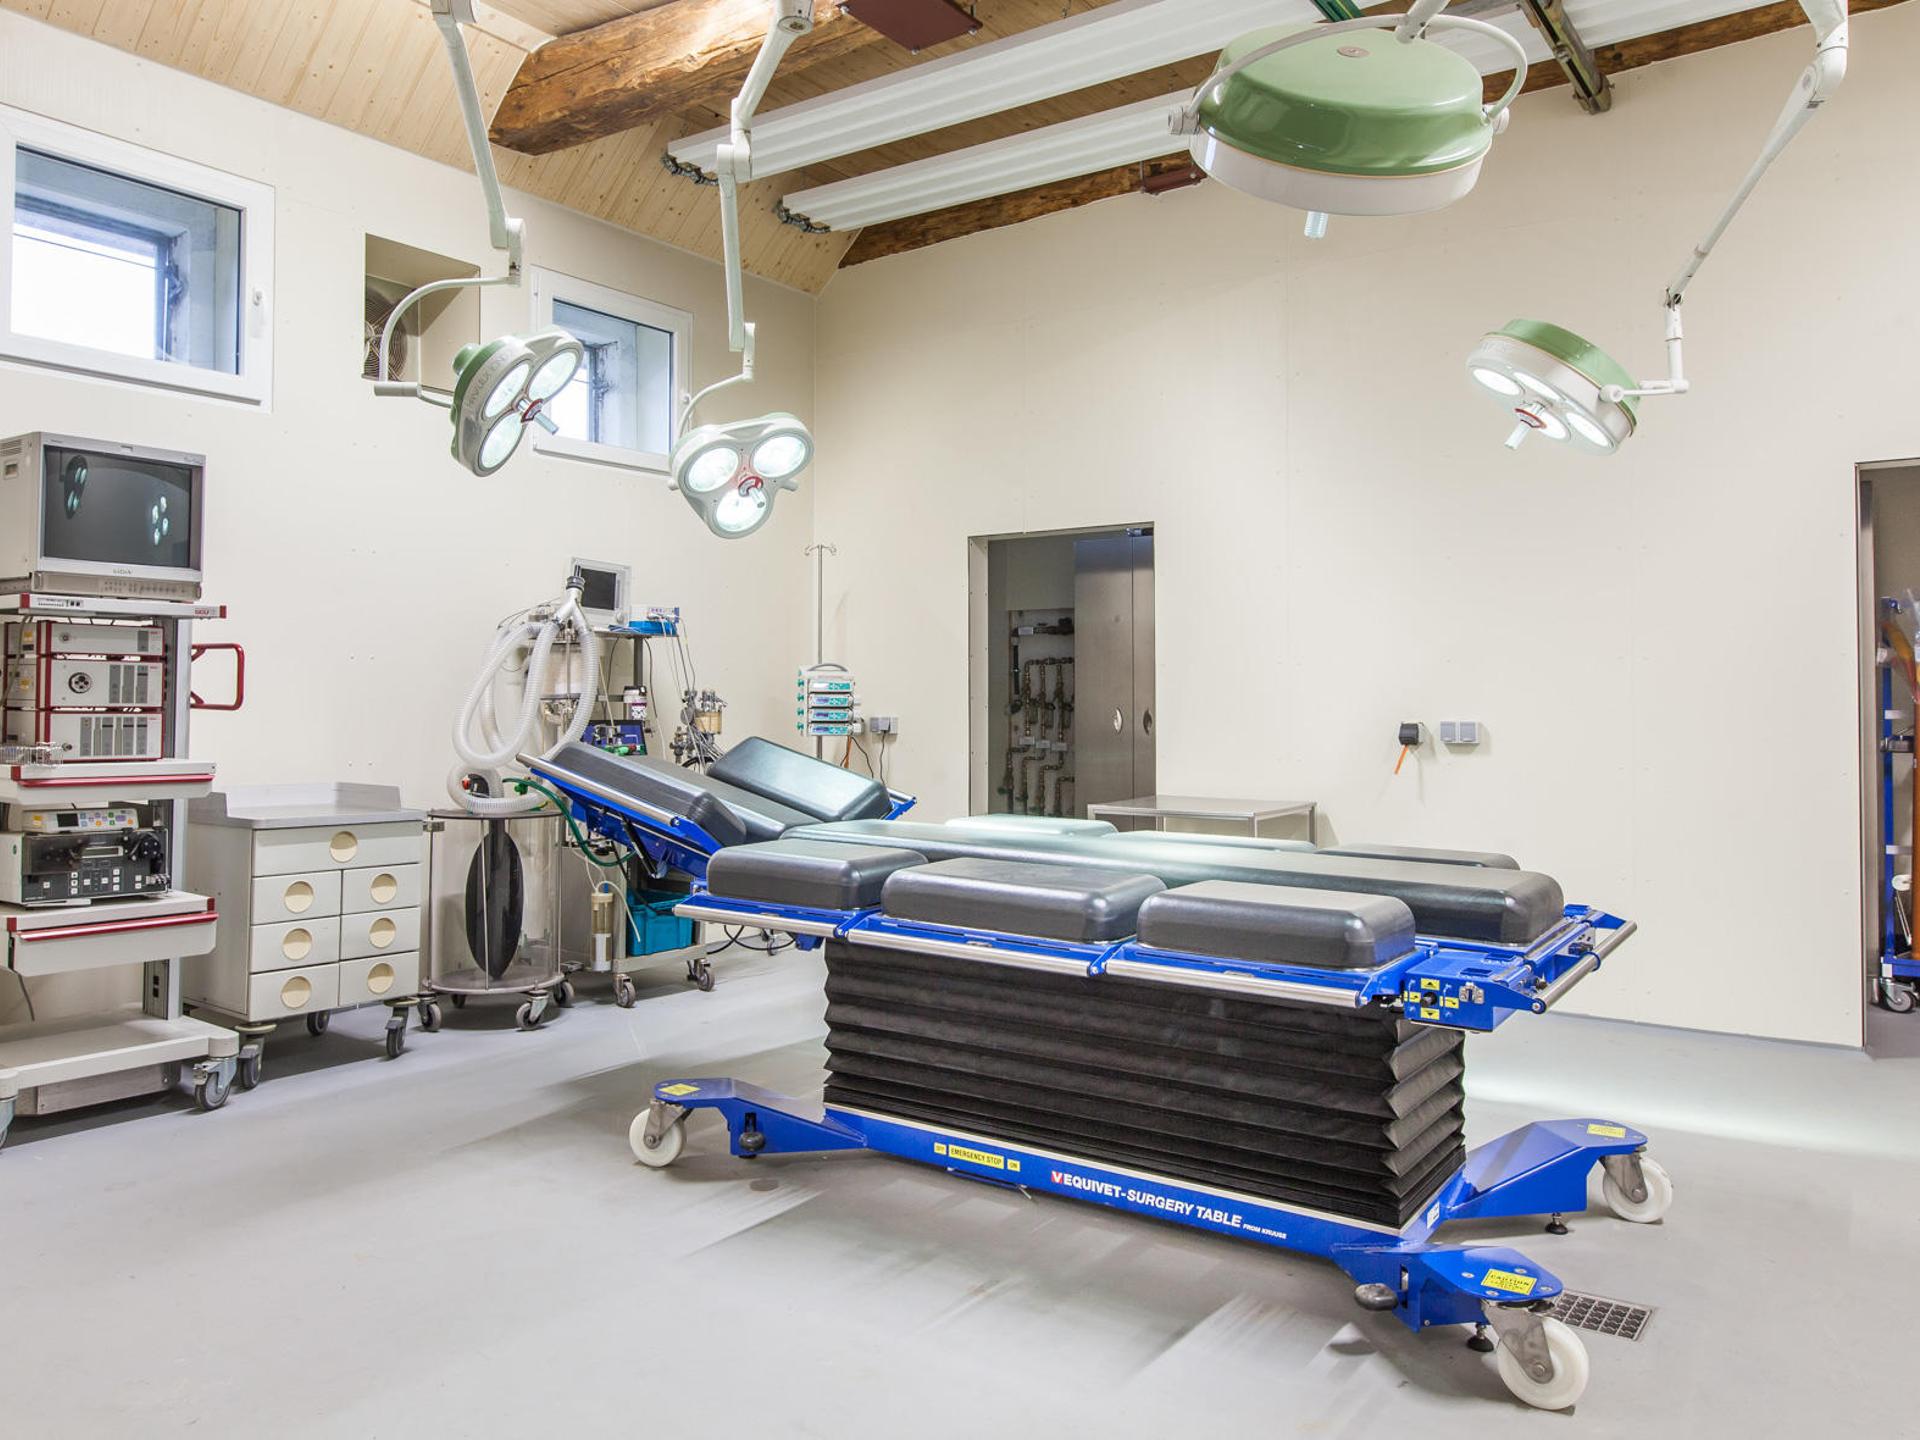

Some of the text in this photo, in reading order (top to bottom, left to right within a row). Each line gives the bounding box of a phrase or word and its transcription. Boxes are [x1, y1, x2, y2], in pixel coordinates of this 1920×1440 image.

[951, 1147, 1002, 1167] EMERGENCY STOP
[1196, 1205, 1243, 1228] TABLE
[1243, 1223, 1261, 1233] FROM
